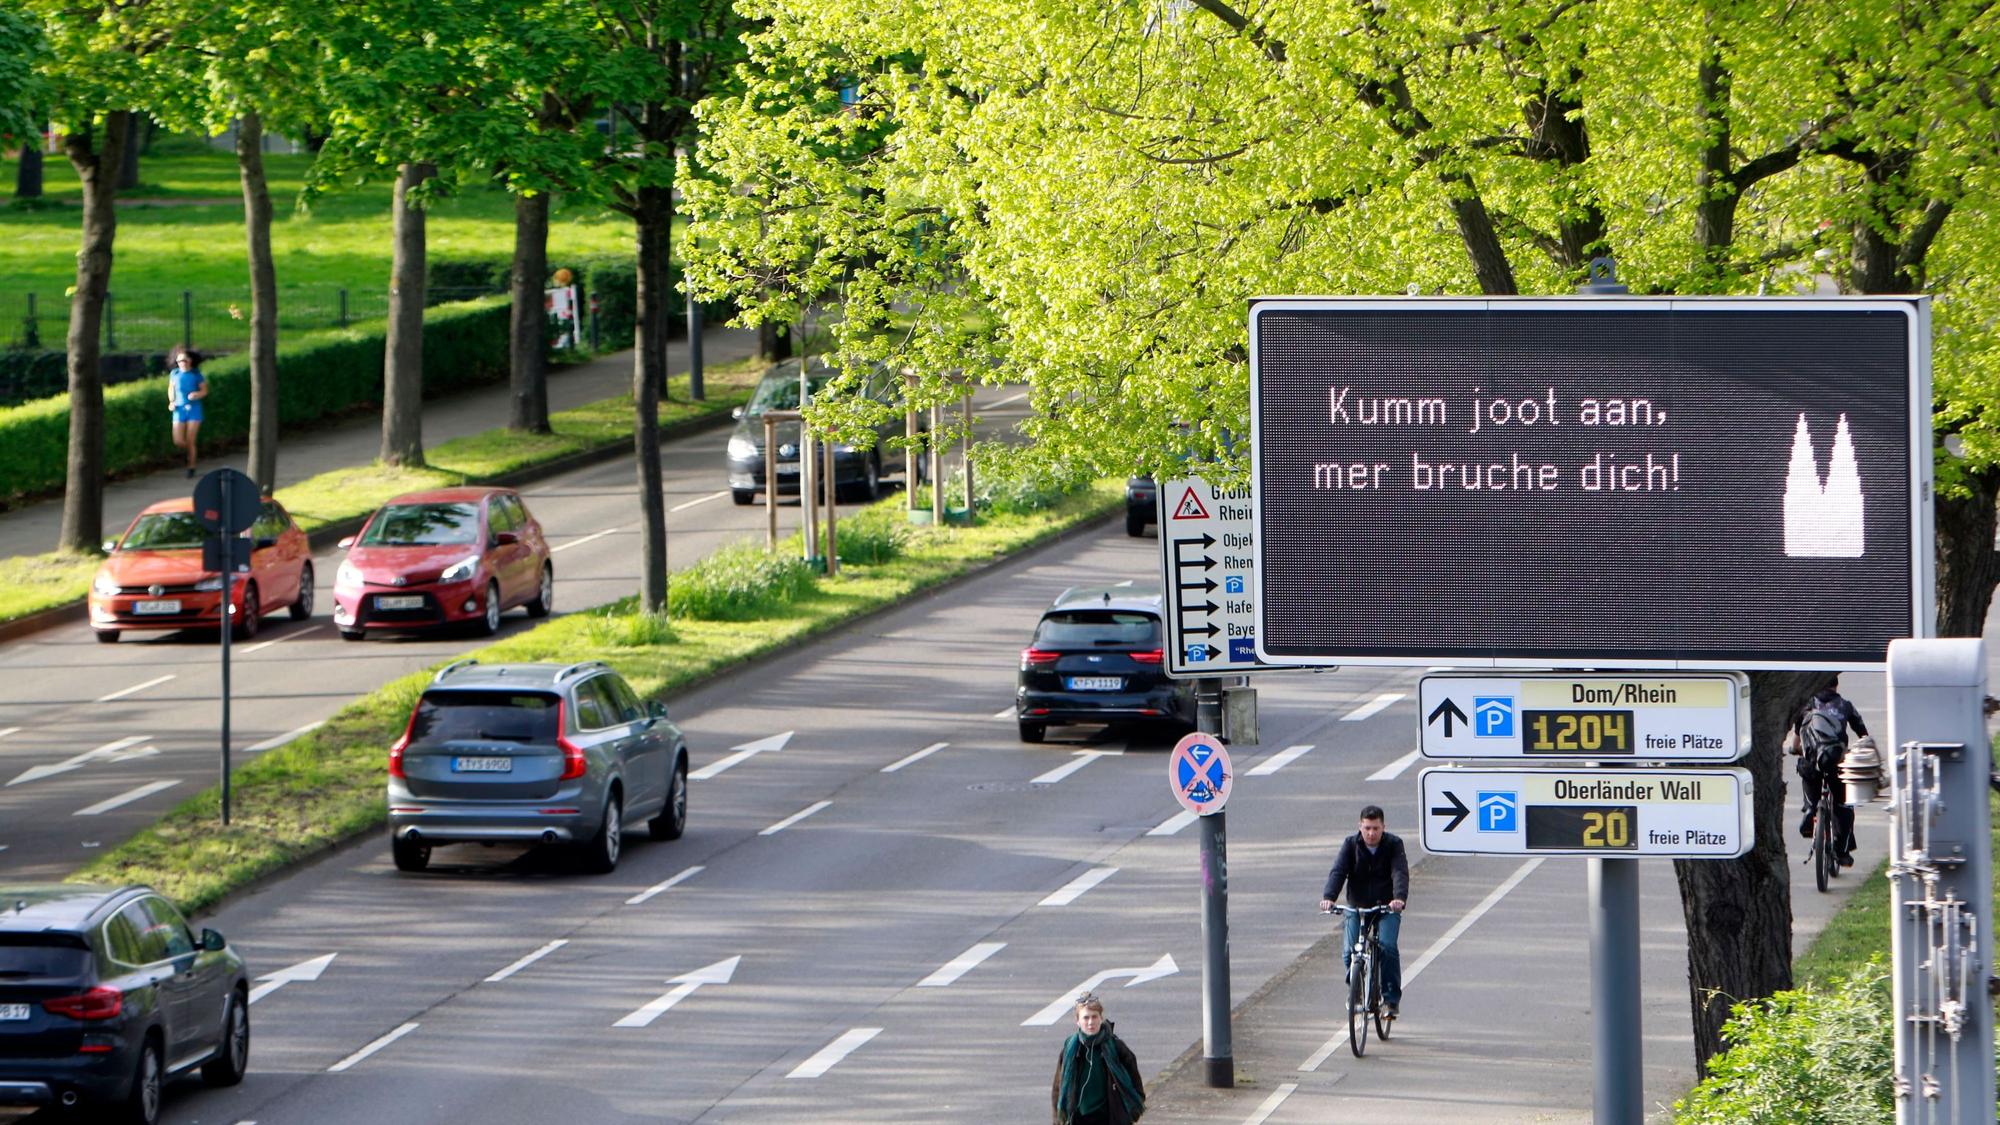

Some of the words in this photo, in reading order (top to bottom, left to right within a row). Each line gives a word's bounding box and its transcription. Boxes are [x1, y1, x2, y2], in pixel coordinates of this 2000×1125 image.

[1329, 386, 1446, 425] Kumm
[1469, 387, 1560, 434] joot
[1580, 397, 1668, 426] aan,
[1314, 463, 1390, 490] mer
[1413, 453, 1559, 491] bruche
[1580, 453, 1681, 491] dich!
[1226, 599, 1252, 614] Hafe
[1571, 683, 1677, 706] Dom/Rhein
[1532, 715, 1625, 750] 1204
[1645, 733, 1677, 750] freie
[1682, 732, 1723, 751] Plätze
[1554, 779, 1653, 801] Oberländer
[1660, 780, 1701, 801] Wall
[1582, 812, 1629, 847] 20
[1649, 829, 1681, 846] freie
[1685, 827, 1727, 846] Plätze
